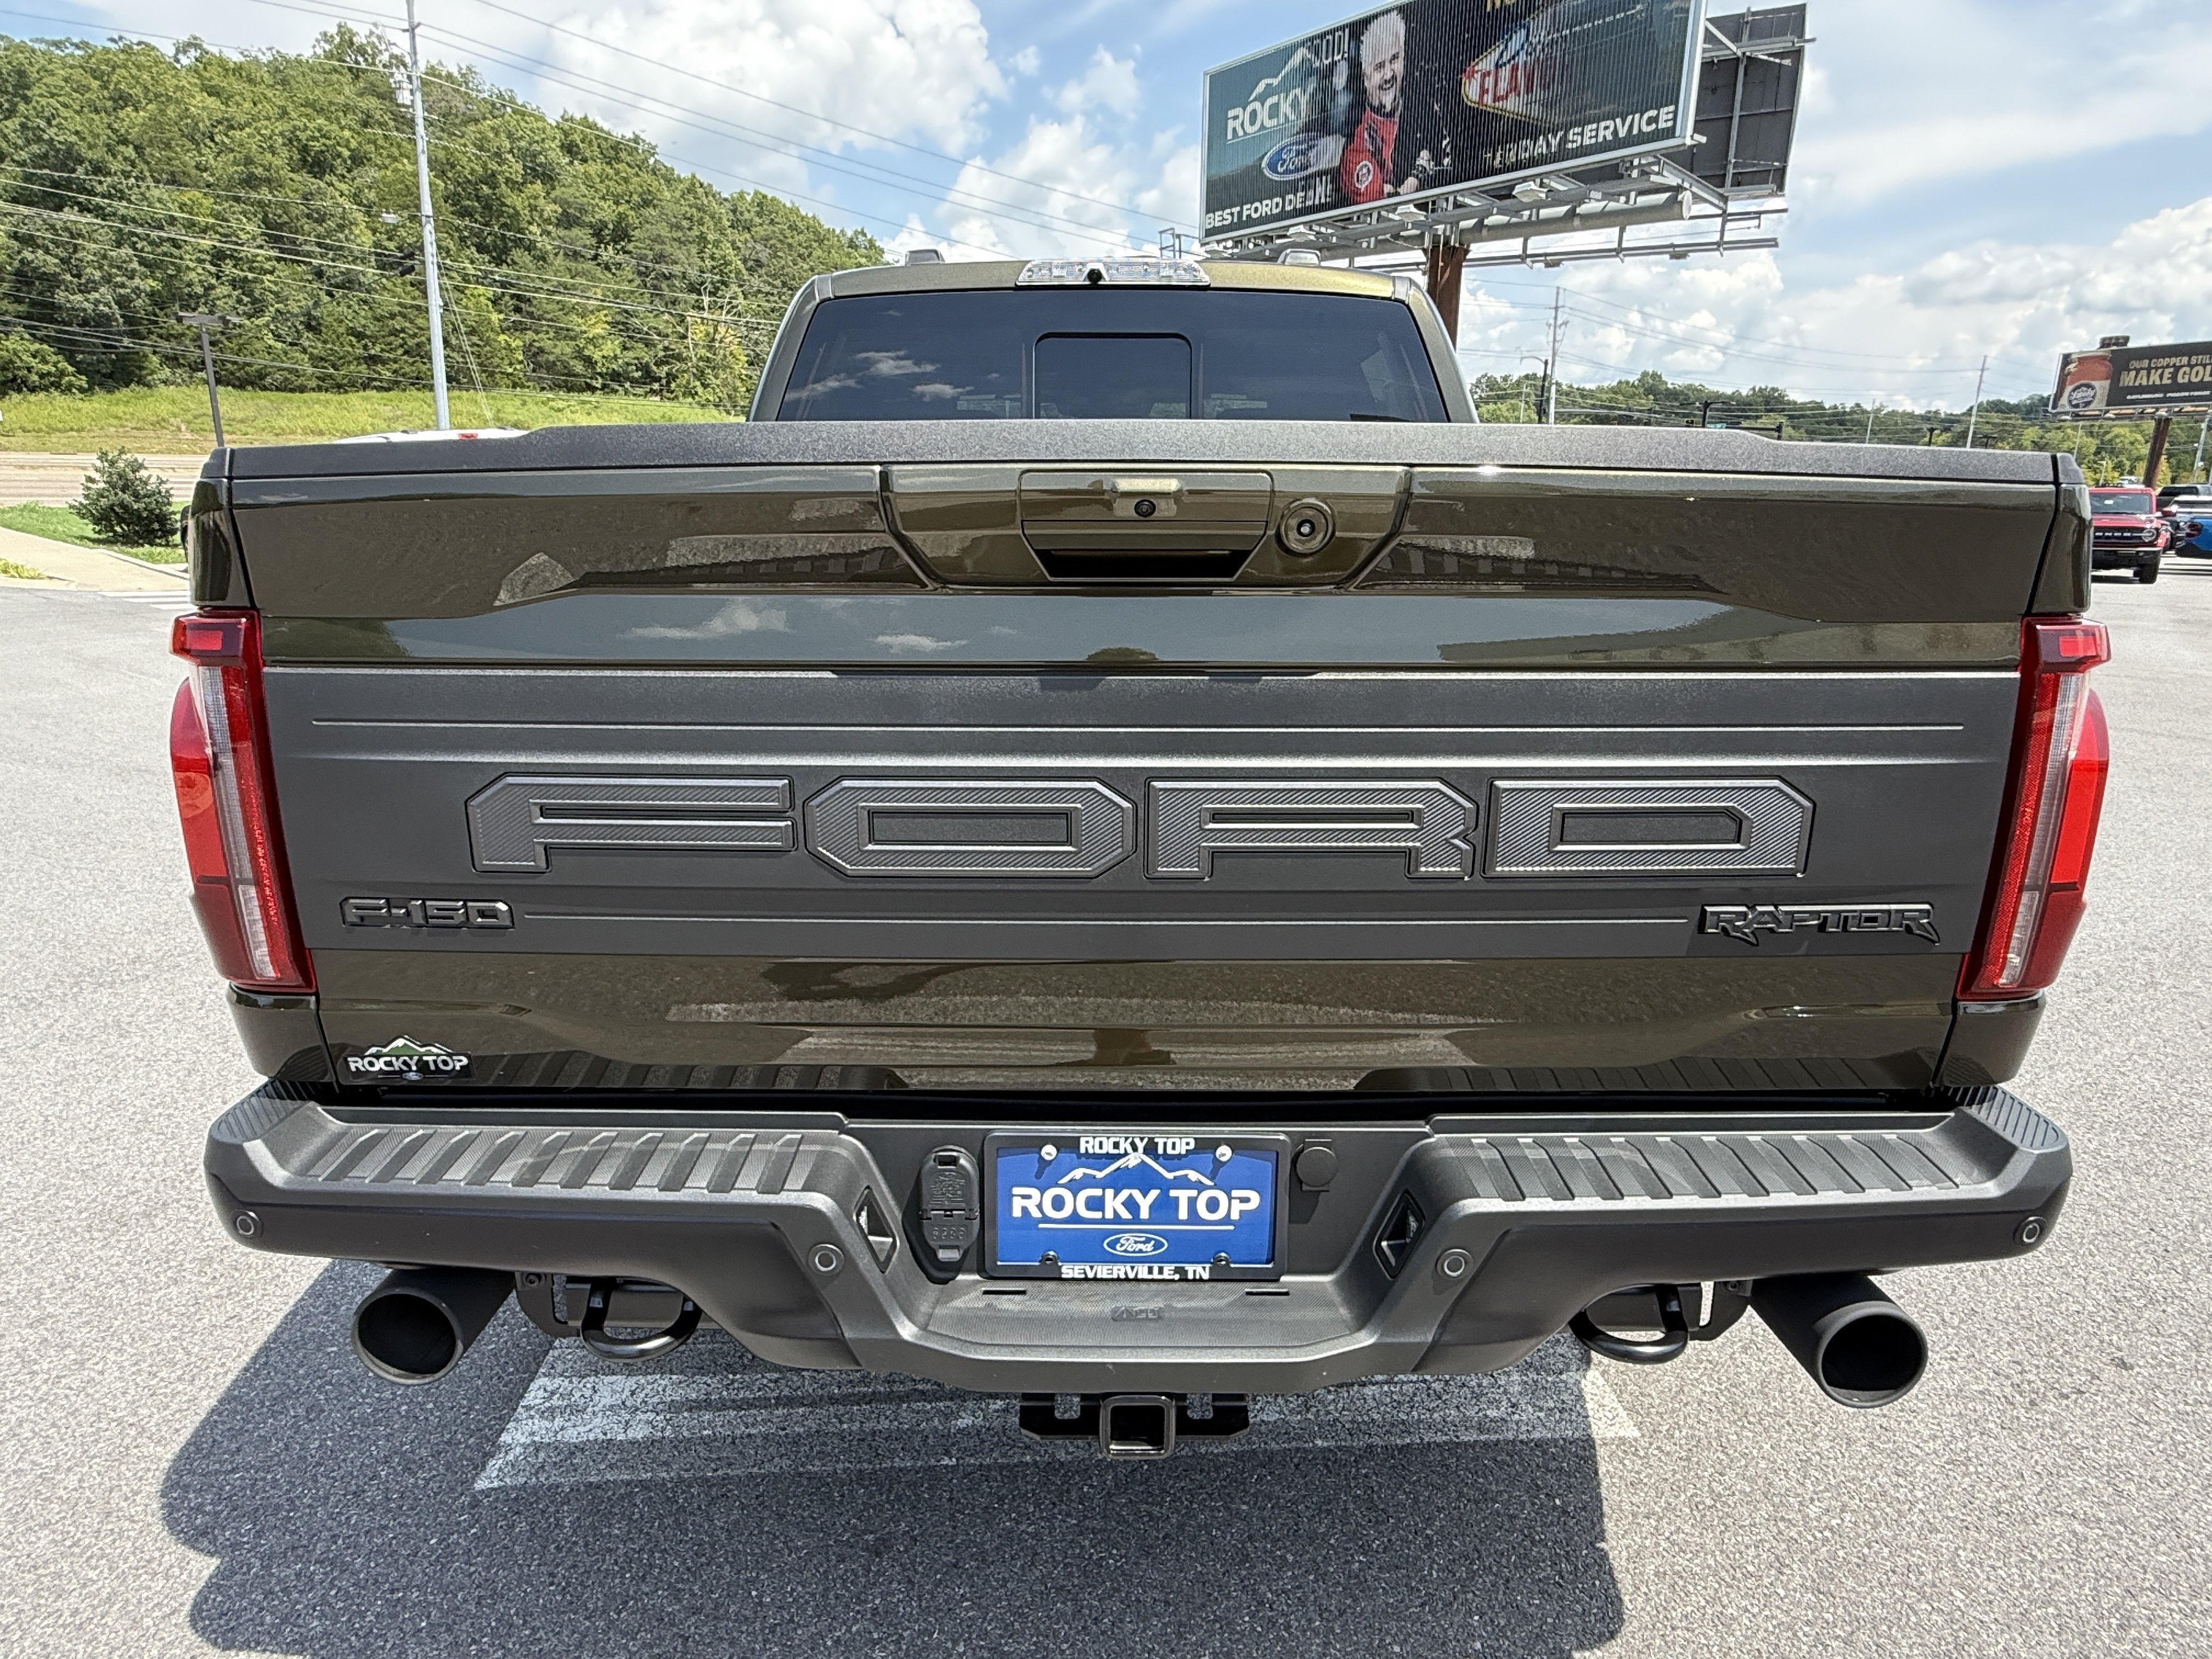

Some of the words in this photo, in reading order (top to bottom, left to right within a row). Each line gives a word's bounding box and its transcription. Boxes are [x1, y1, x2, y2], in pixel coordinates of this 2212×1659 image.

[1566, 105, 1675, 149] SERVICE
[1206, 206, 1240, 229] BEST
[1242, 197, 1283, 221] FORD
[2129, 360, 2149, 369] OUR
[2151, 356, 2189, 368] COPPER
[2119, 368, 2175, 387] MAKE
[464, 774, 1815, 881] FORD
[340, 897, 515, 929] F-150
[1699, 902, 1940, 947] RAPTOR
[347, 1057, 419, 1071] ROCKY
[422, 1056, 469, 1070] TOP
[1080, 1137, 1149, 1154] ROCKY
[1154, 1138, 1195, 1155] TOP
[1012, 1187, 1159, 1220] ROCKY
[1170, 1189, 1261, 1221] TOP
[1115, 1236, 1155, 1252] Ford
[1061, 1265, 1180, 1280] SEVIERVILLE,
[1184, 1266, 1210, 1280] TN
